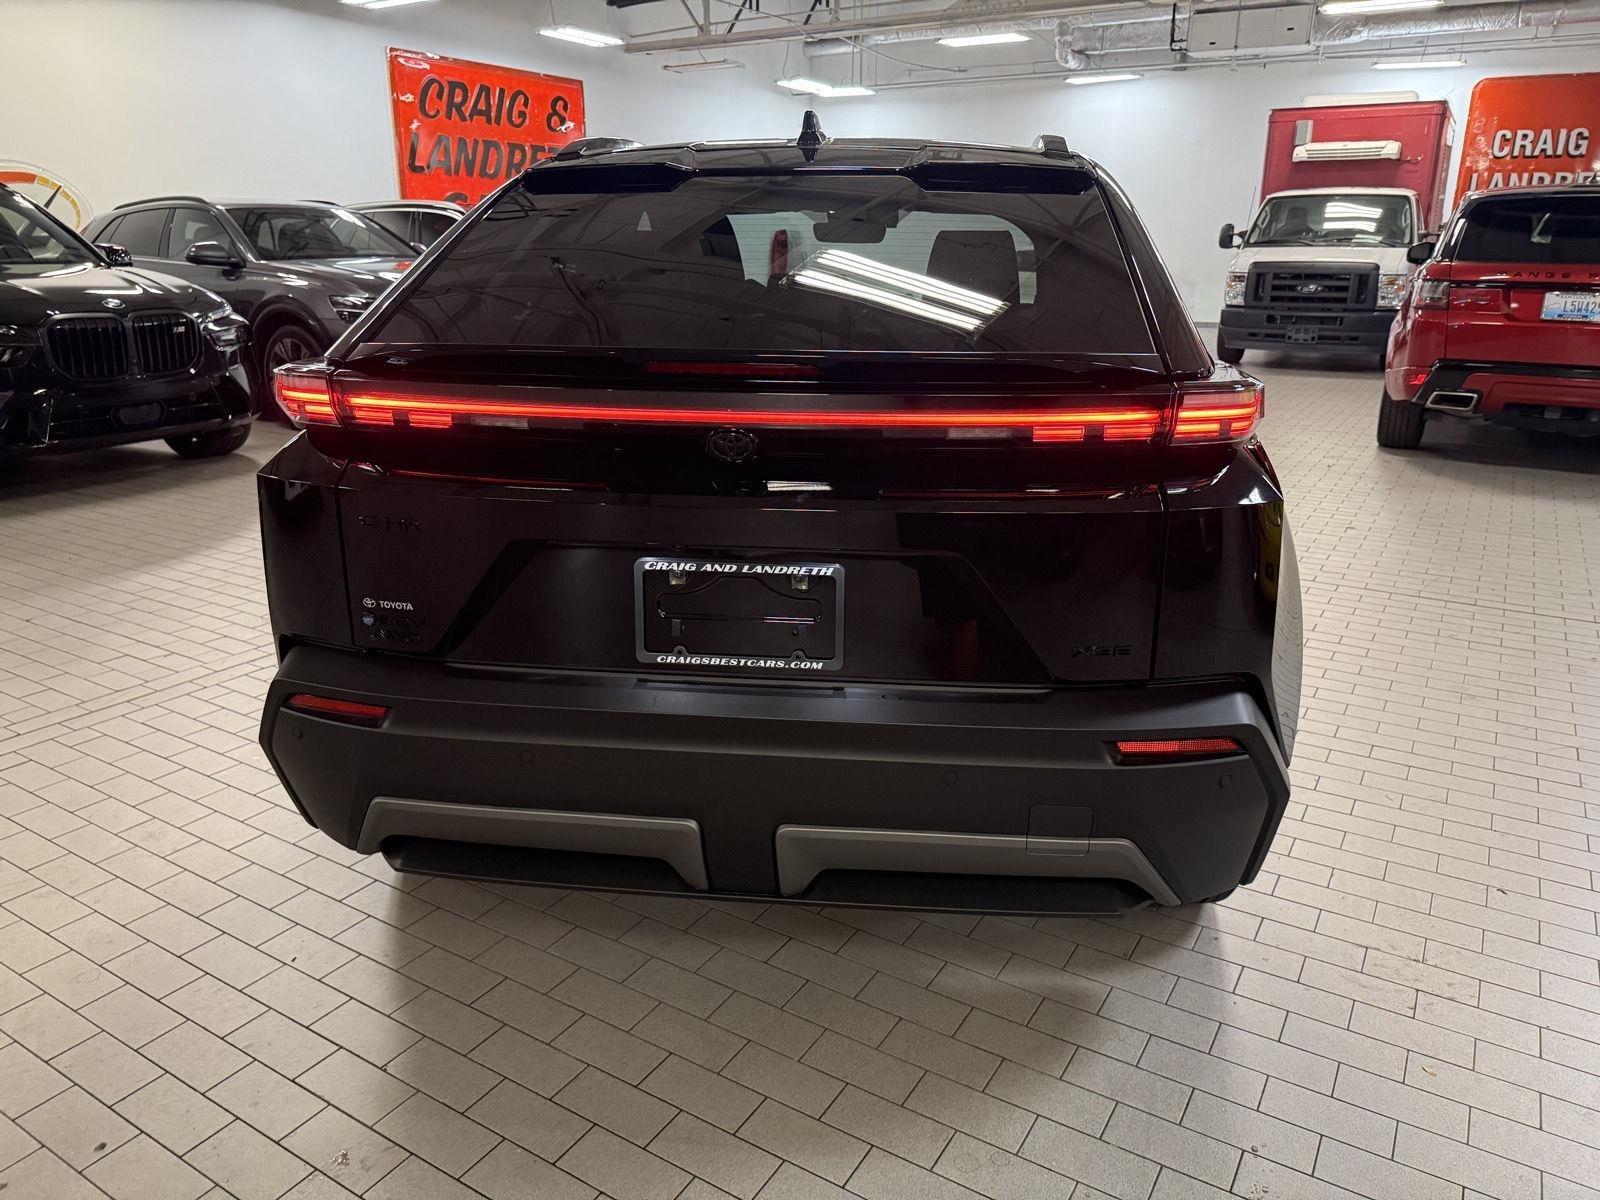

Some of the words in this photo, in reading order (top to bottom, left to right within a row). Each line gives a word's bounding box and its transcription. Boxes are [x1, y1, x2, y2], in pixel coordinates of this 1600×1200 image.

[418, 77, 530, 128] CRAIG
[546, 95, 571, 133] &
[1492, 127, 1590, 158] CRAIG
[407, 132, 562, 180] LANDRE
[644, 561, 697, 572] CRAIG
[701, 563, 738, 573] AND
[742, 564, 835, 576] LANDRETH
[379, 600, 414, 611] TOYOTA
[656, 655, 824, 670] CRAIGSBESTCARS.COM
